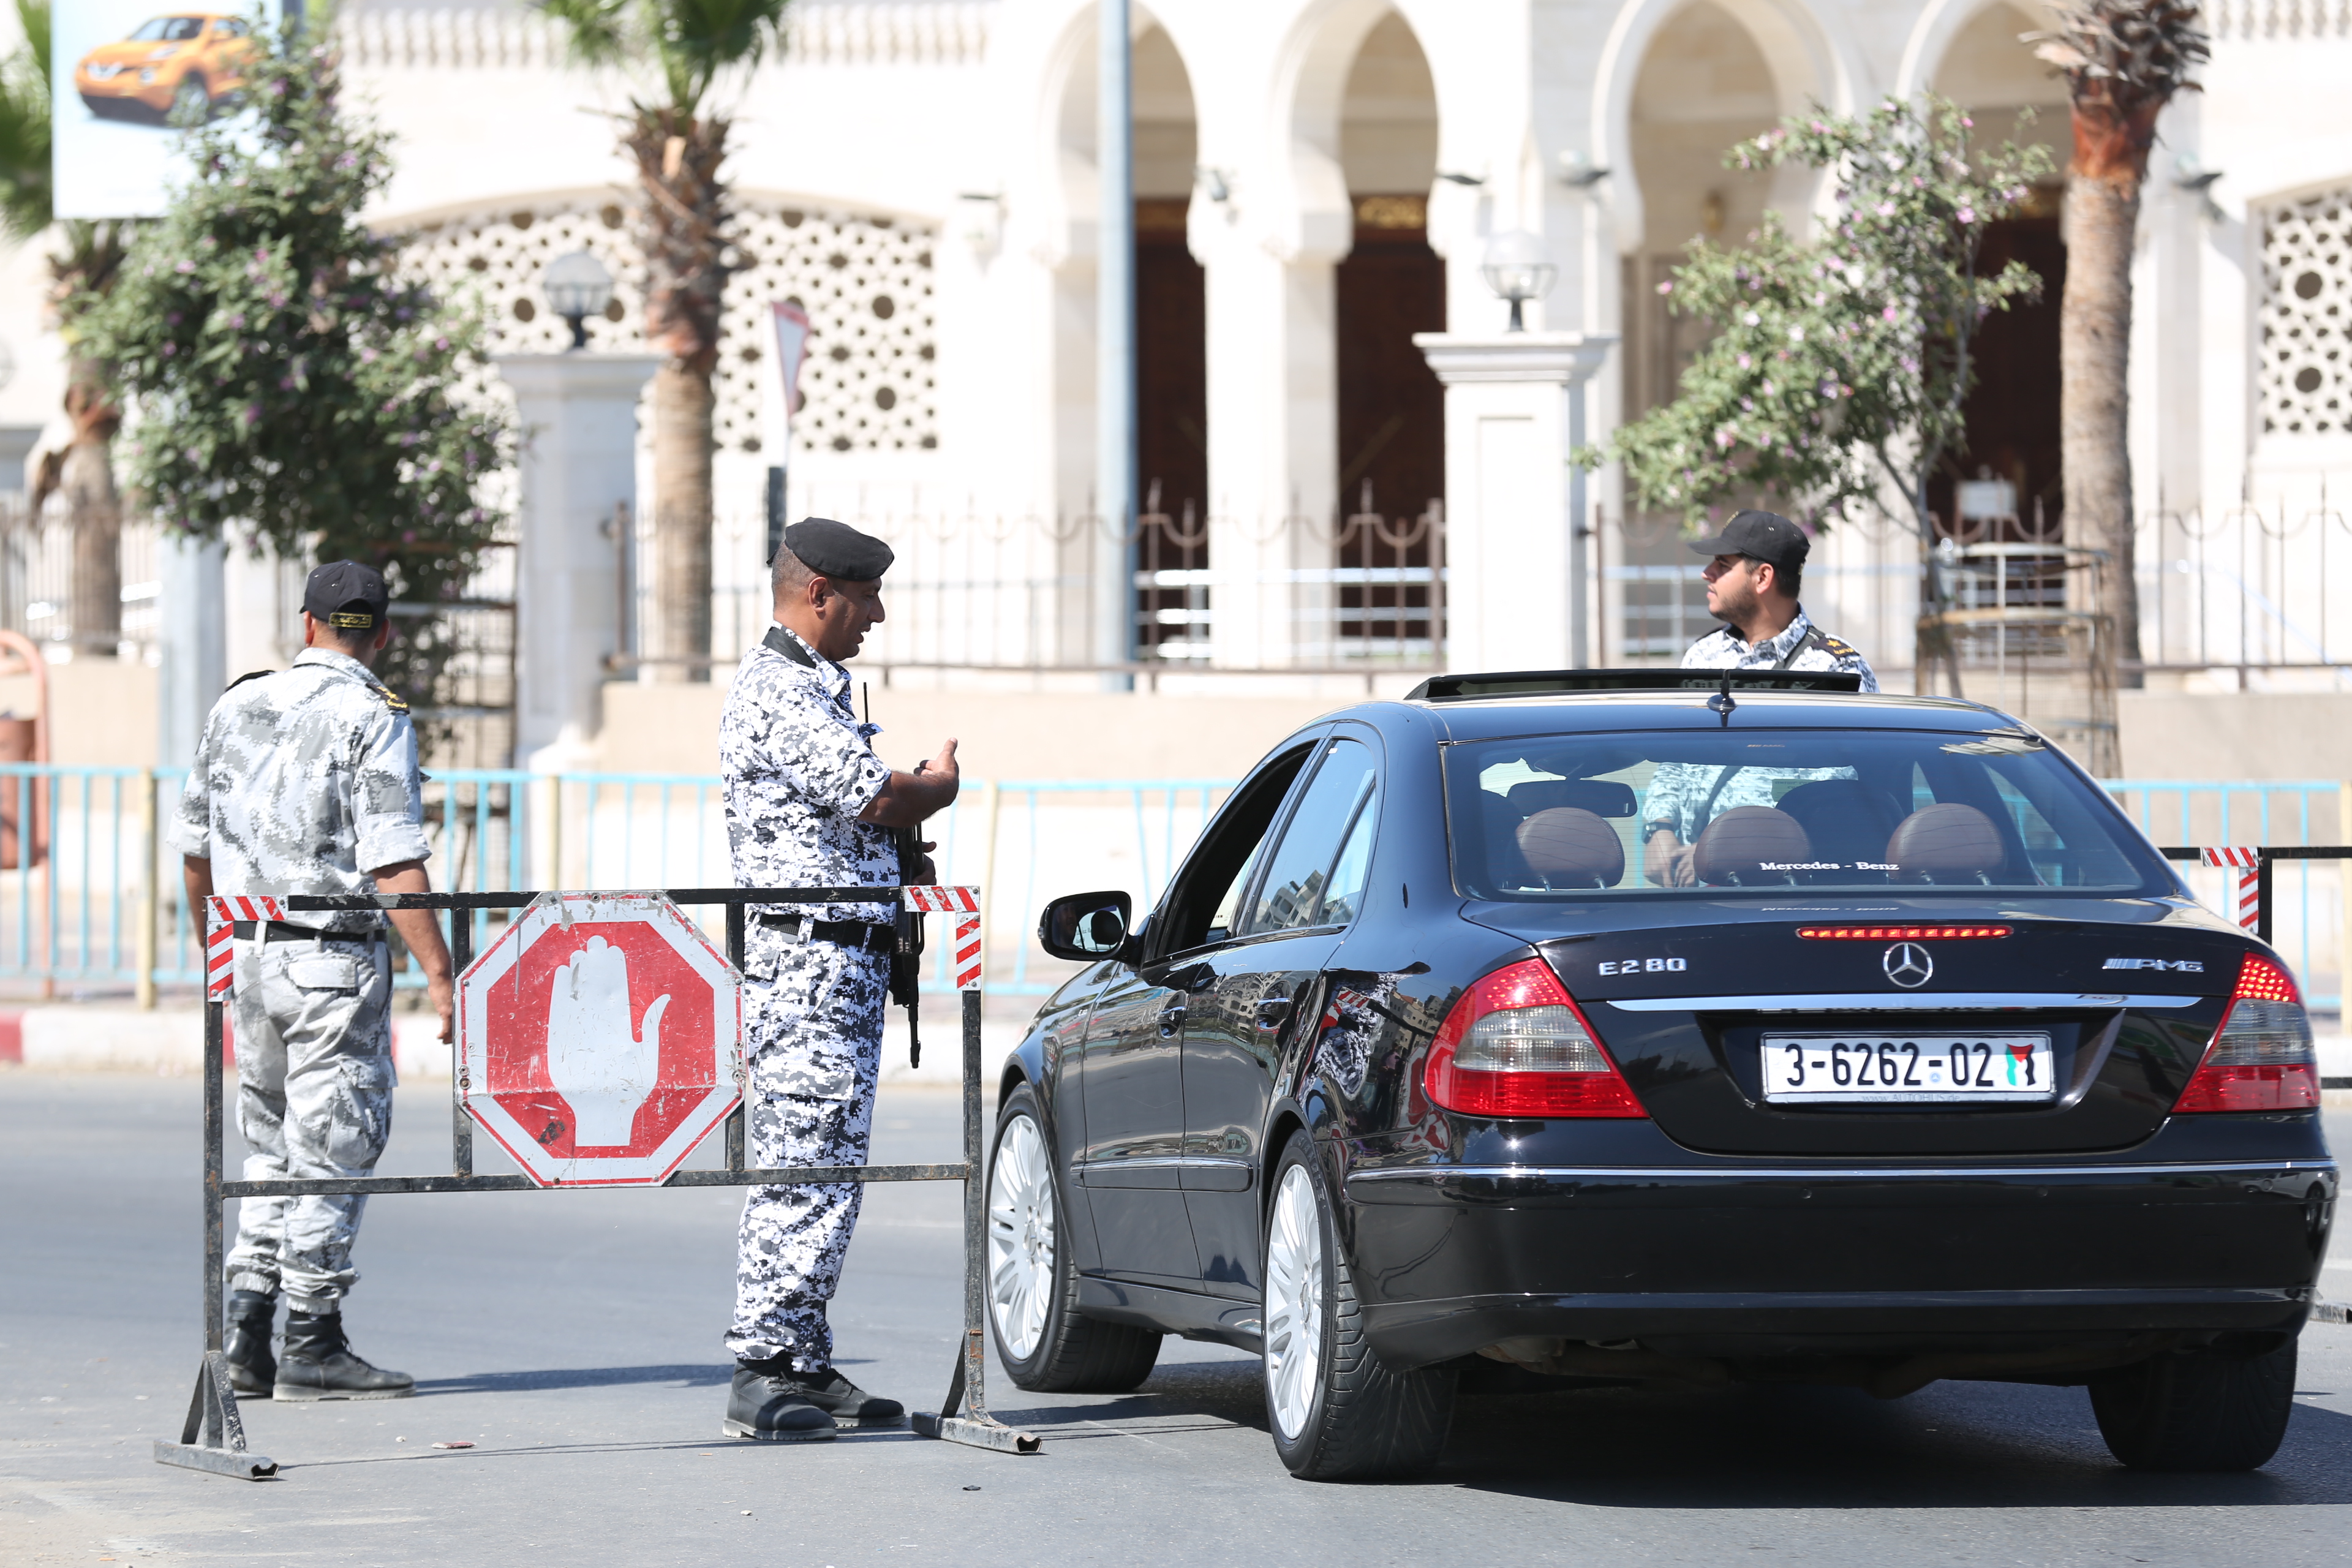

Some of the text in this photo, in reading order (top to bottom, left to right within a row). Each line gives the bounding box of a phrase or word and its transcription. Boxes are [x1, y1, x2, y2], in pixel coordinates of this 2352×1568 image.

[1758, 862, 1841, 870] Mercedes
[1855, 862, 1900, 870] Benz
[1785, 1042, 1994, 1087] 3-6262-02
